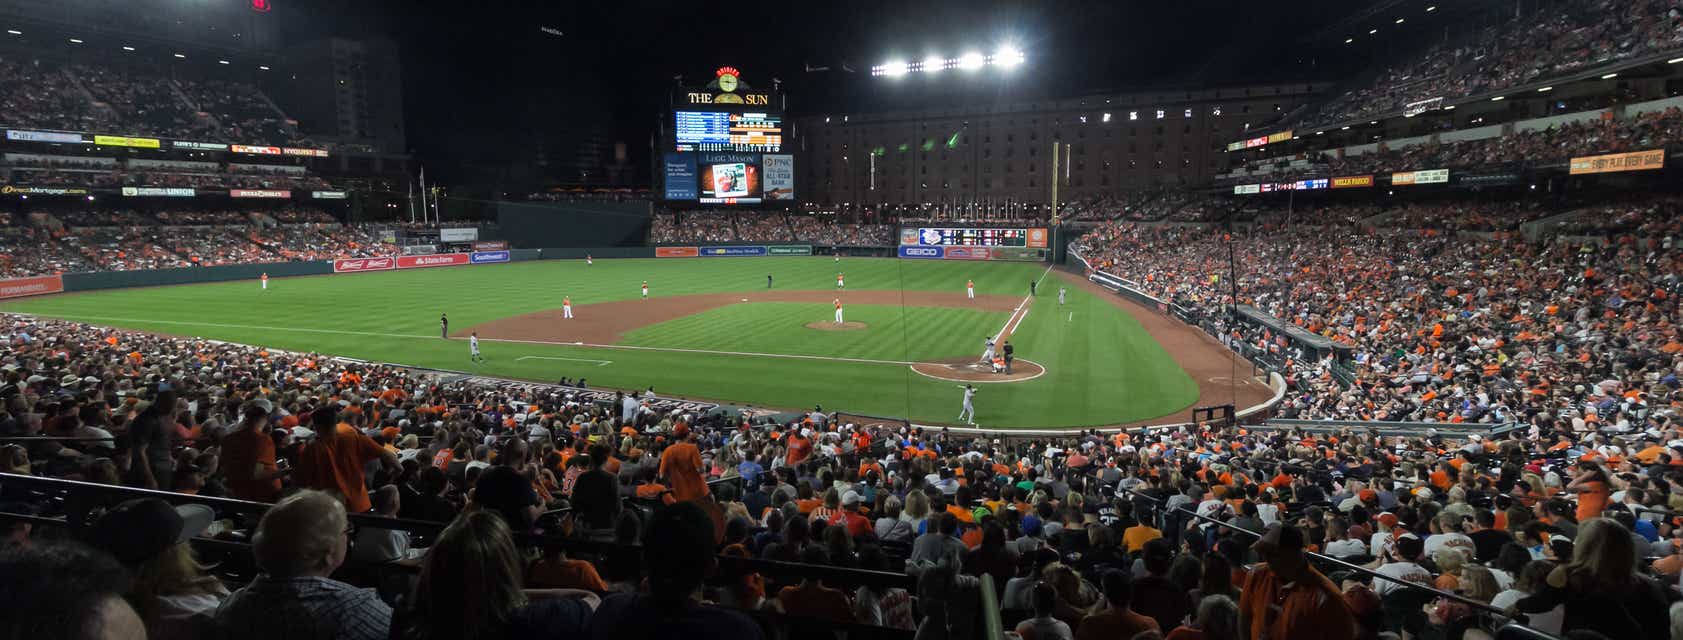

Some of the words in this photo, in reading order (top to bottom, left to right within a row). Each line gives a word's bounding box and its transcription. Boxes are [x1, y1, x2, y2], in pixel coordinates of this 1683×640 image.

[688, 92, 713, 104] THE
[745, 94, 768, 105] SUN
[167, 188, 195, 196] UNION
[906, 248, 937, 256] GEICO
